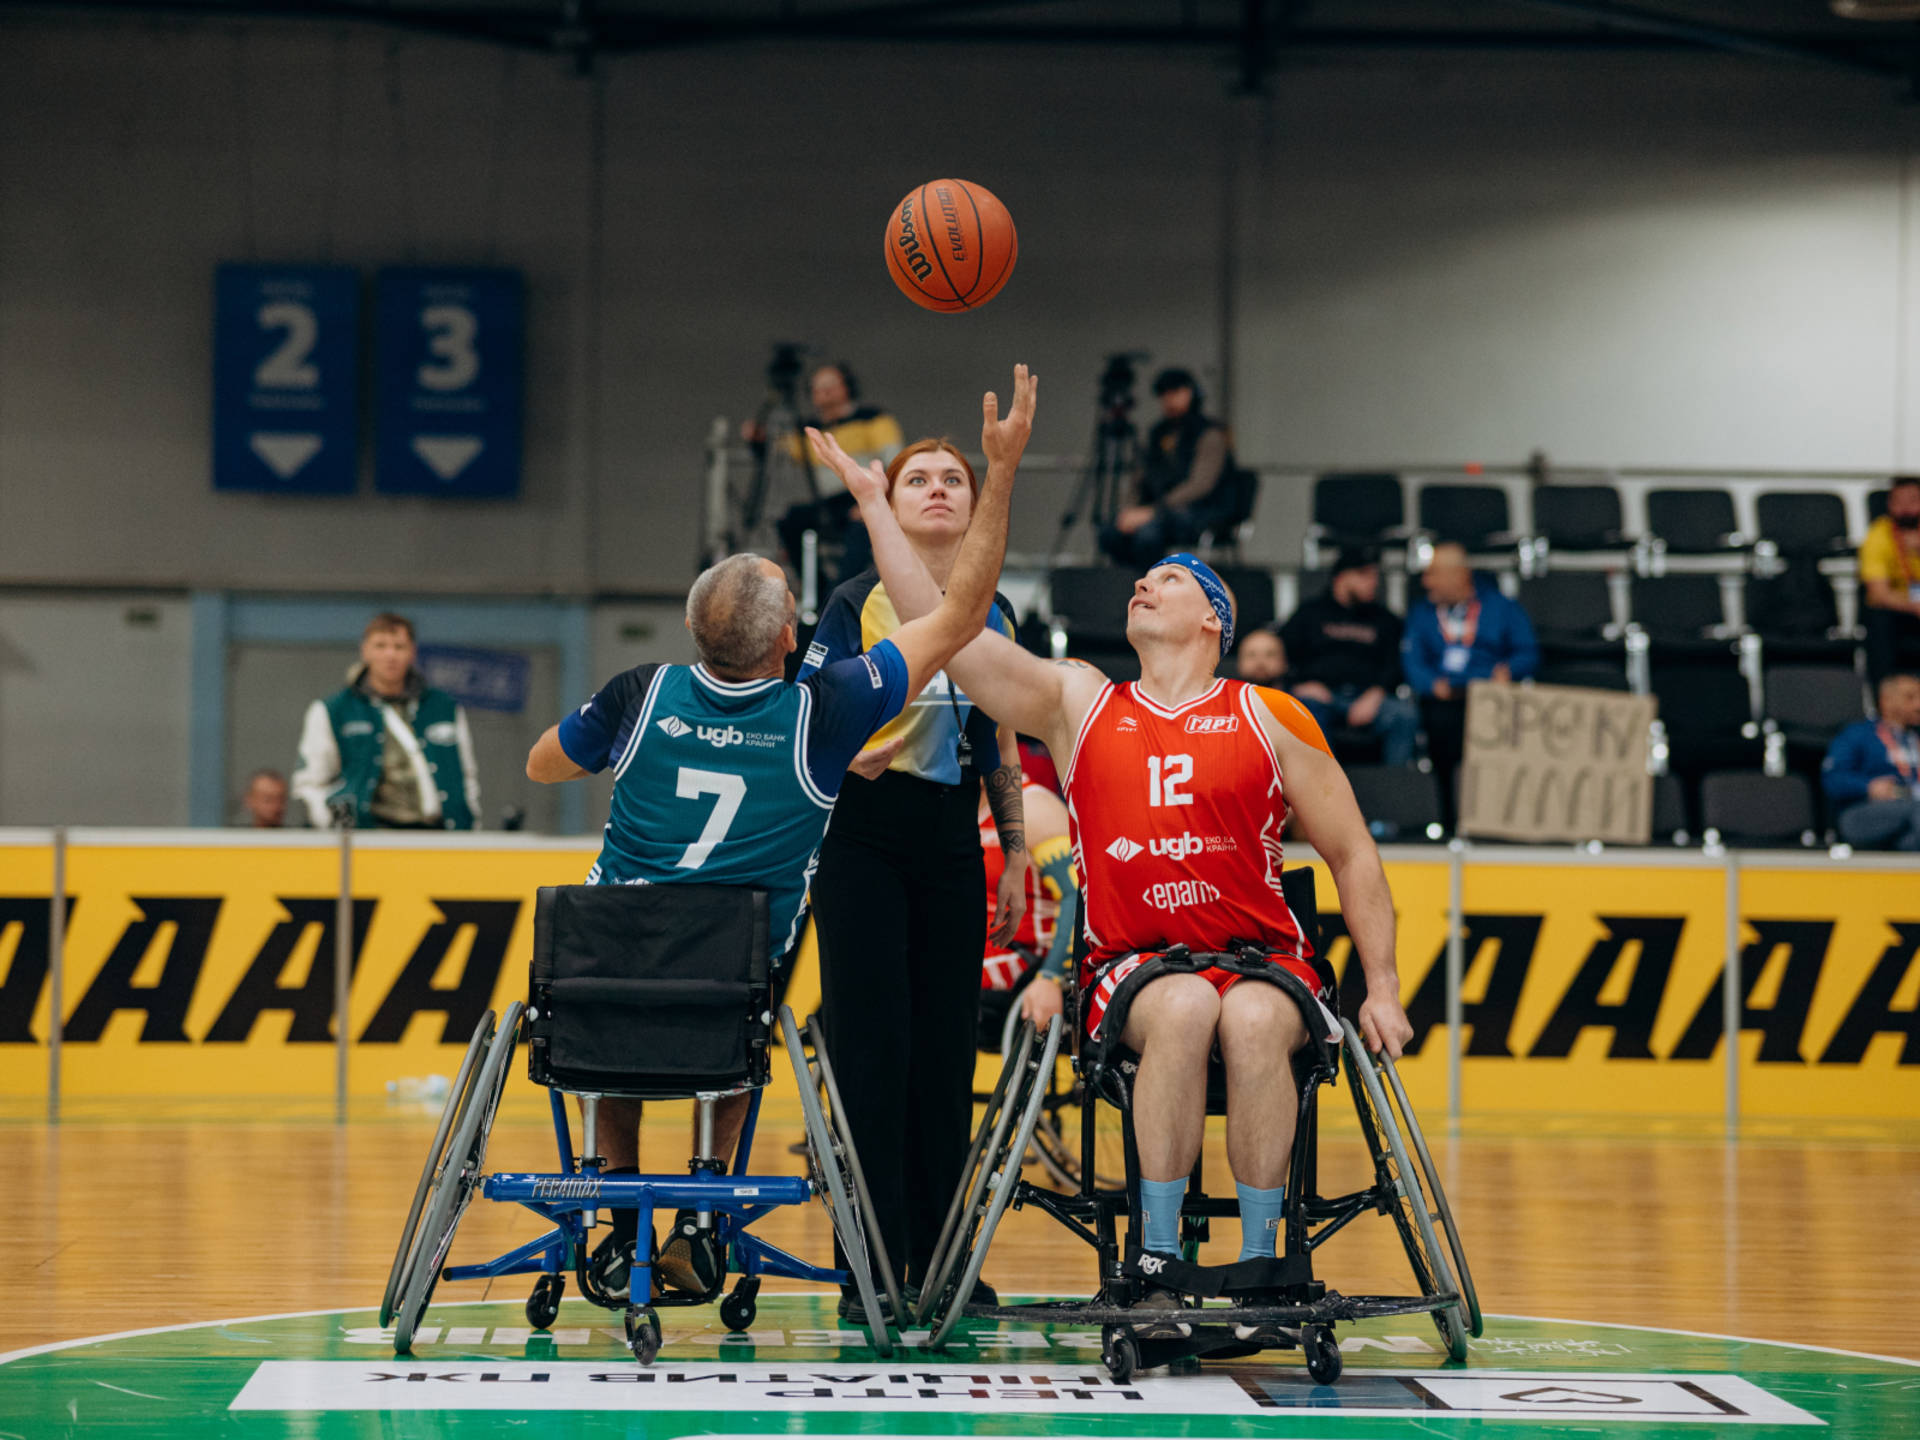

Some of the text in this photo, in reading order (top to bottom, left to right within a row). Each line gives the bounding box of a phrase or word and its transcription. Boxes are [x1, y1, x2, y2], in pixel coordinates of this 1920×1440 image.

[899, 198, 932, 282] Wilson
[256, 301, 319, 389] 2
[418, 304, 479, 391] 3
[696, 725, 744, 748] ugb
[675, 766, 747, 870] 7
[1147, 753, 1194, 807] 12
[1148, 832, 1204, 861] ugb
